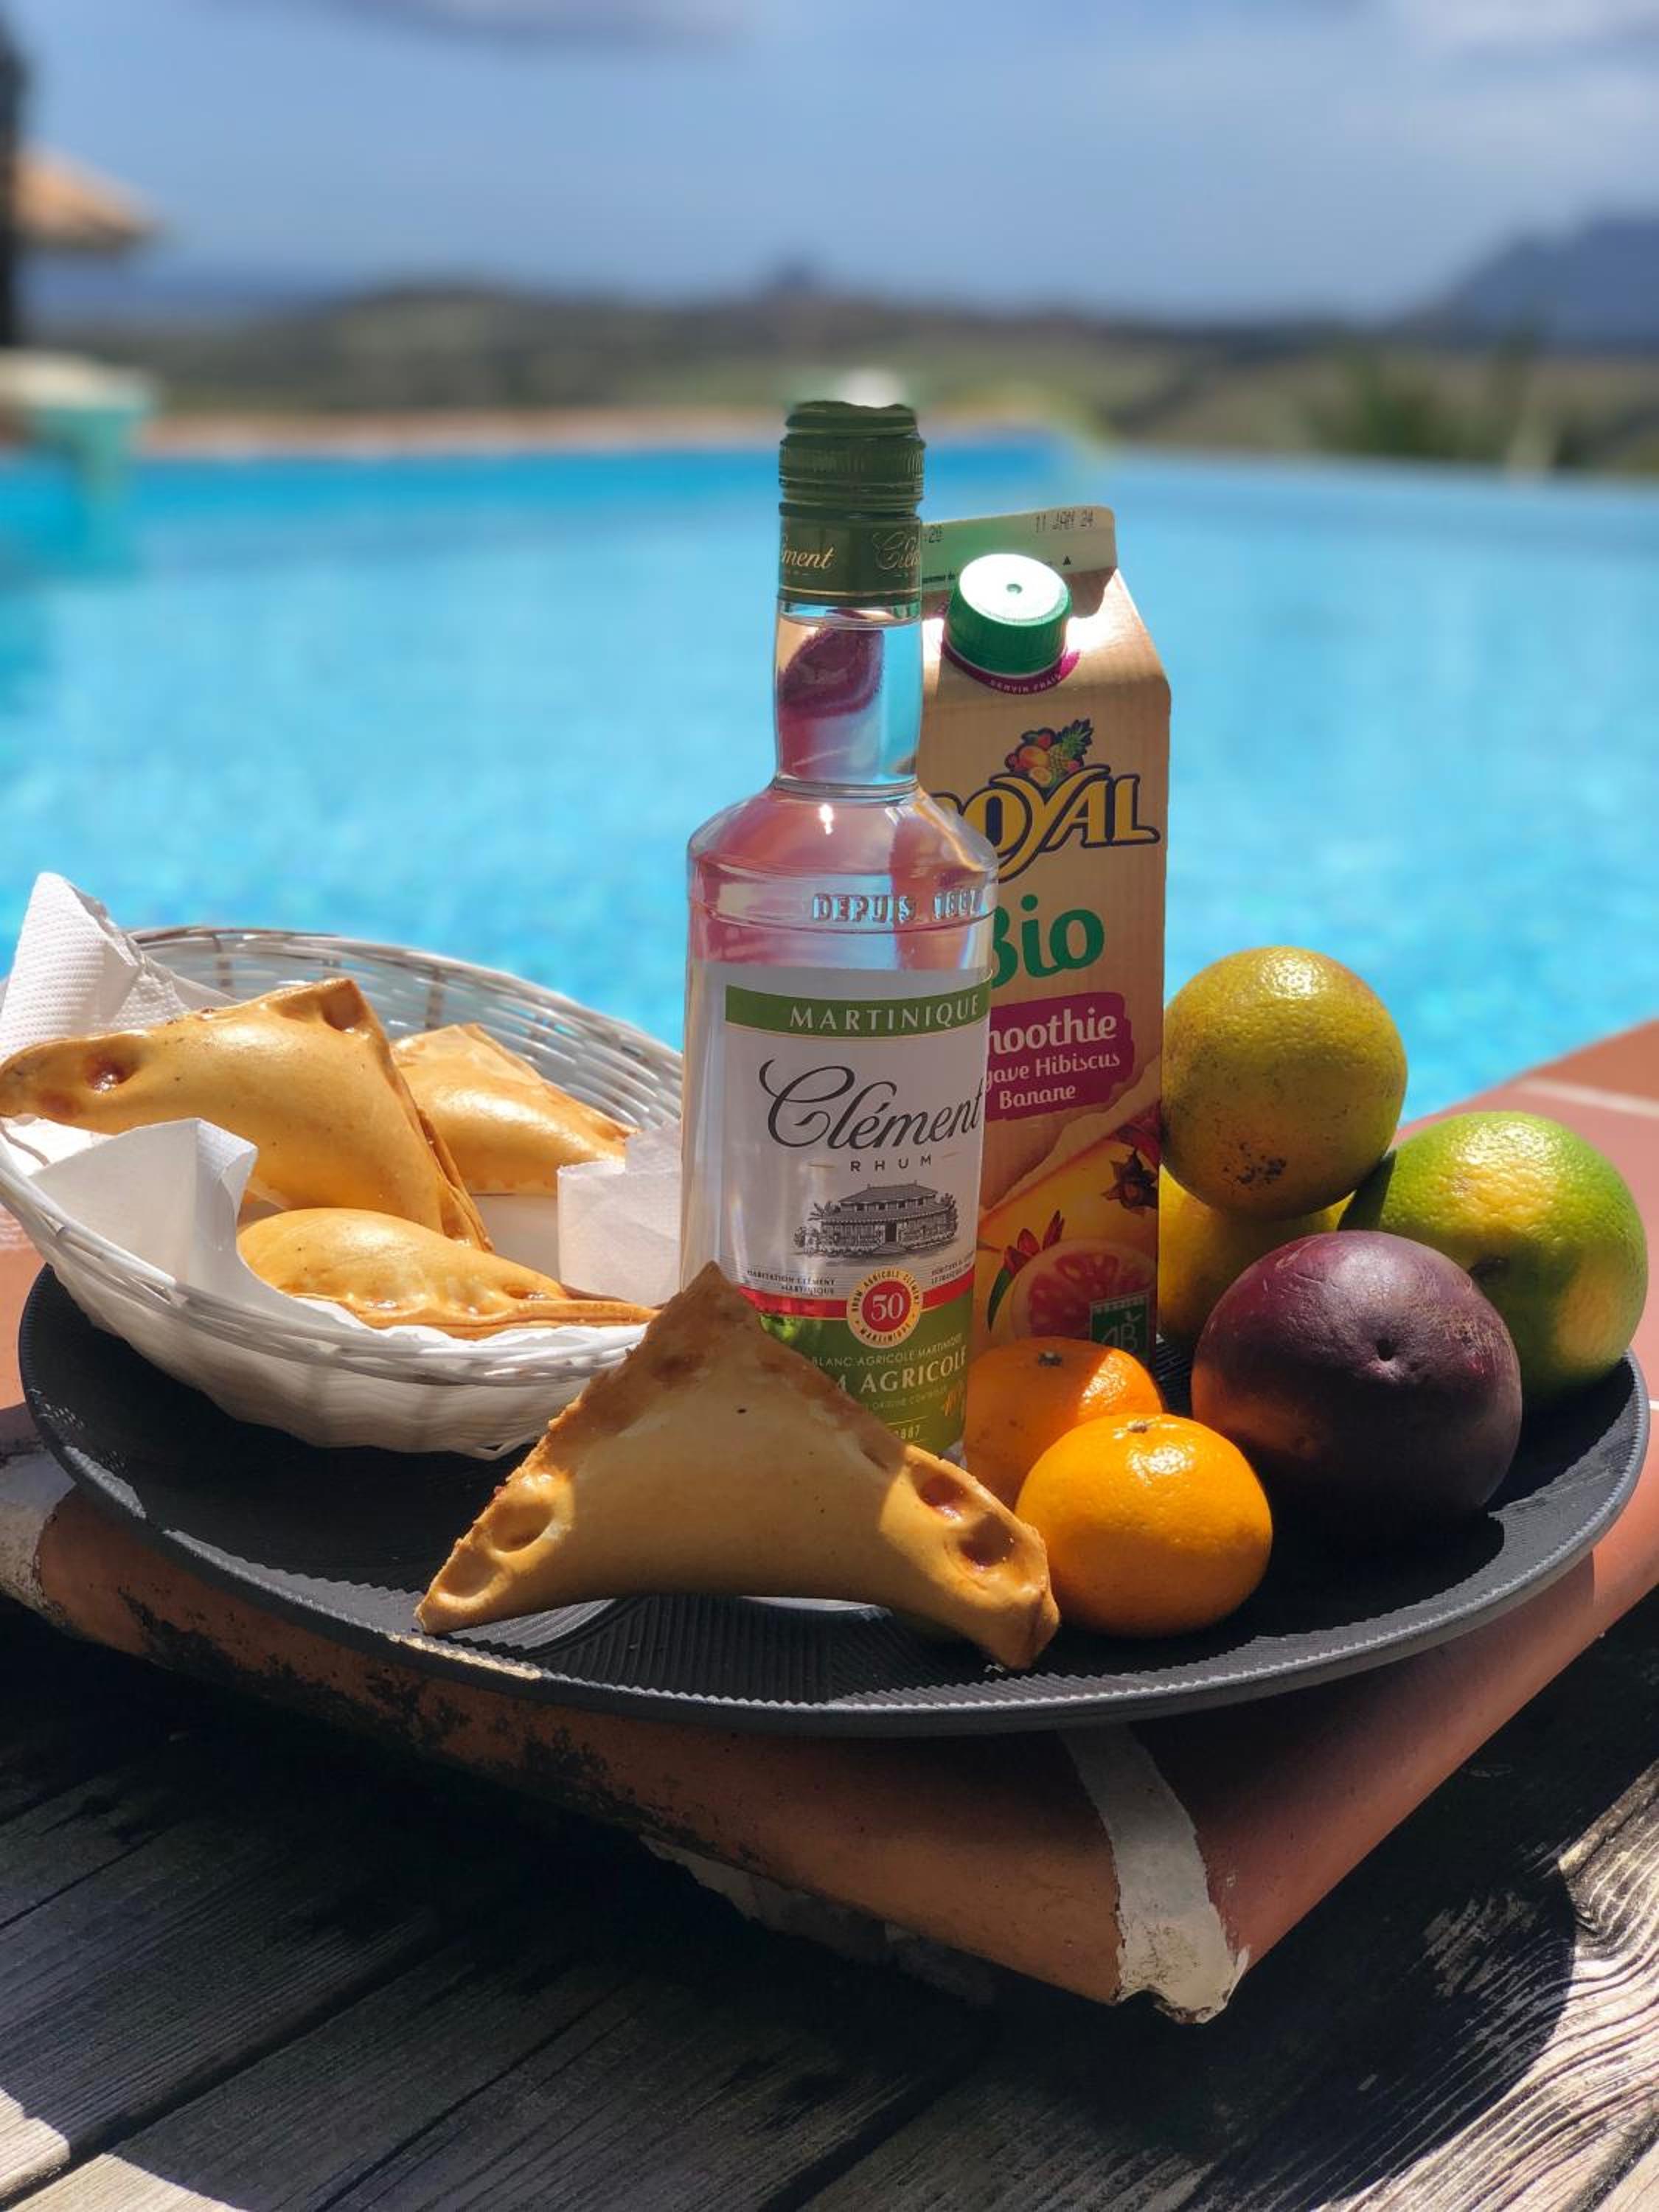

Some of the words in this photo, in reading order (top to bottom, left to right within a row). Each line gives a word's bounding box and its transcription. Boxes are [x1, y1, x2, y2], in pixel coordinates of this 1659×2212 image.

[782, 546, 834, 569] ment
[929, 764, 1161, 883] OYAL
[812, 894, 916, 923] DEPUIS
[790, 994, 978, 1031] MARTINIQUE
[990, 1006, 1117, 1055] oothie
[986, 1065, 1029, 1092] yave
[1036, 1053, 1121, 1077] Hibiscus
[759, 1060, 984, 1150] Clément
[999, 1085, 1077, 1110] Banane
[850, 1155, 932, 1172] RHUM
[871, 1292, 904, 1322] 50
[857, 1352, 916, 1367] AGRICOLE
[860, 1344, 967, 1393] AGRICOLE
